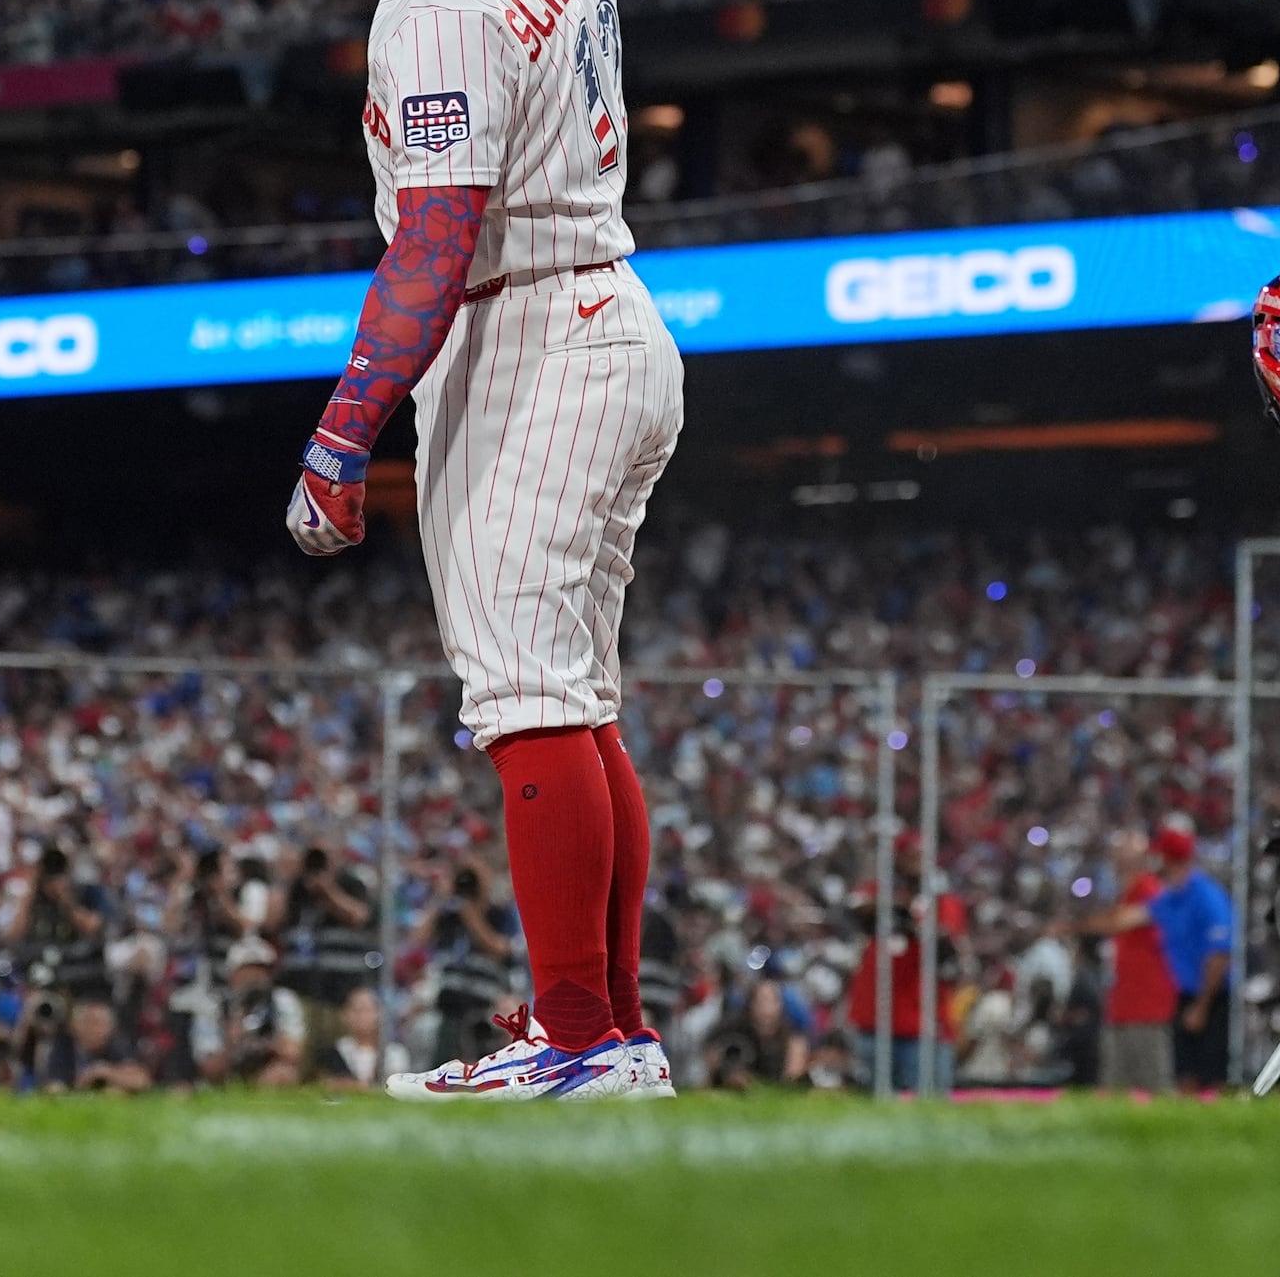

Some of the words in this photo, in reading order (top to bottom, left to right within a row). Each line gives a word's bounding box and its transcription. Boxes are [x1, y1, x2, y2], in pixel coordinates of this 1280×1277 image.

[406, 98, 464, 117] USA
[406, 123, 468, 145] 250
[827, 246, 1076, 323] GEICO
